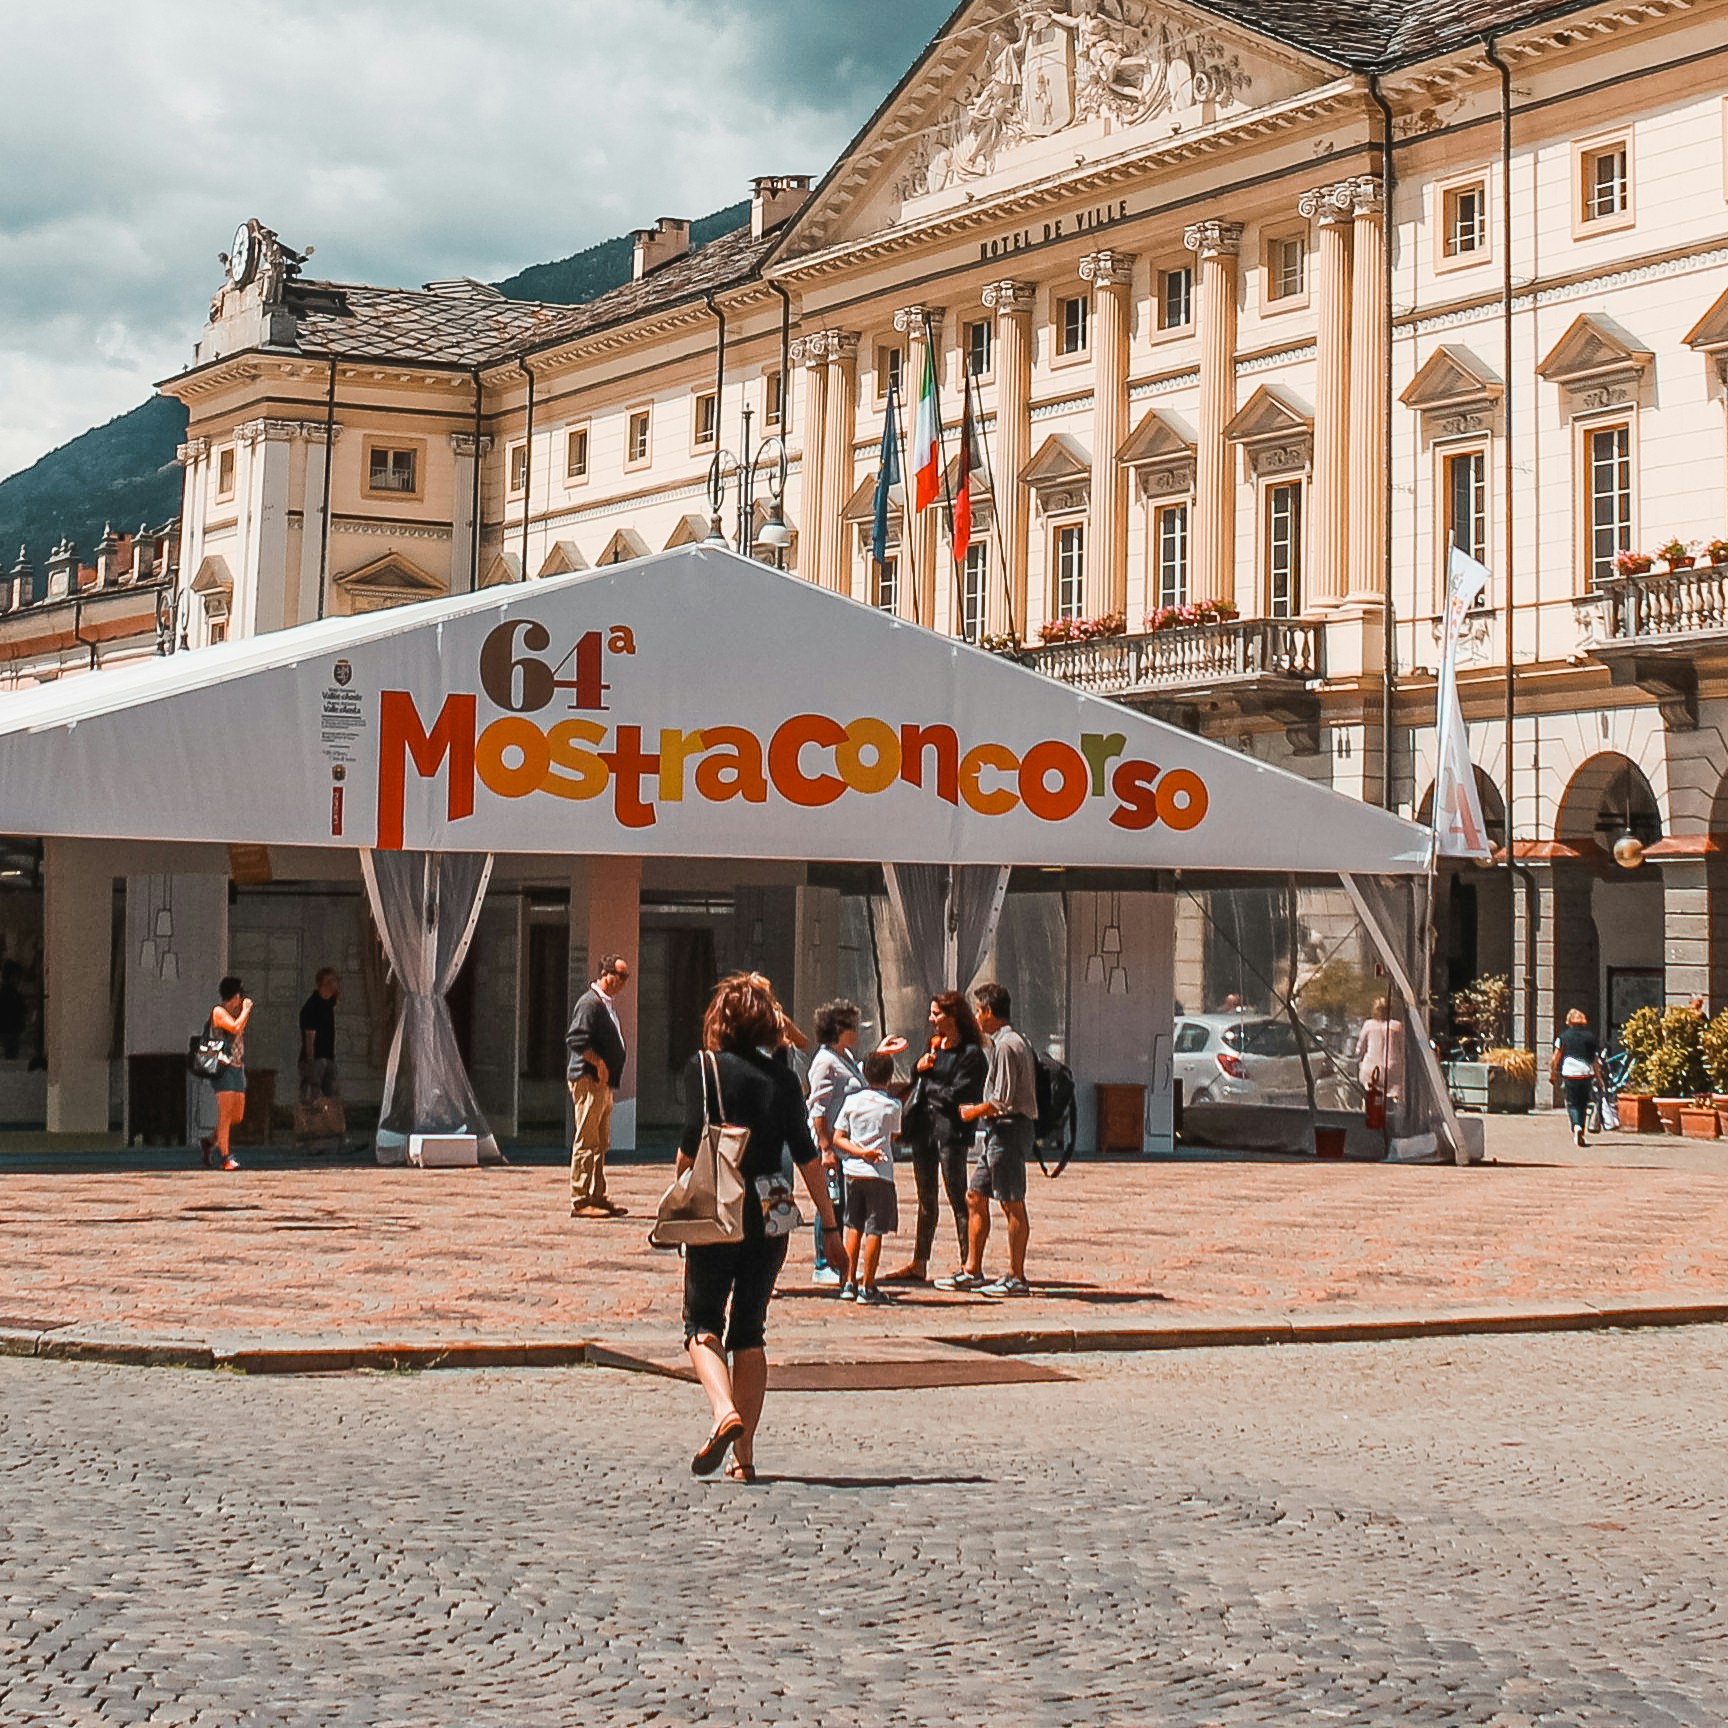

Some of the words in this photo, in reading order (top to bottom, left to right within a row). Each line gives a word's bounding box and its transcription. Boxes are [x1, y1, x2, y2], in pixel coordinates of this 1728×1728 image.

[980, 229, 1032, 260] HOTEL
[1043, 219, 1062, 241] DE
[1076, 199, 1127, 231] VILLE
